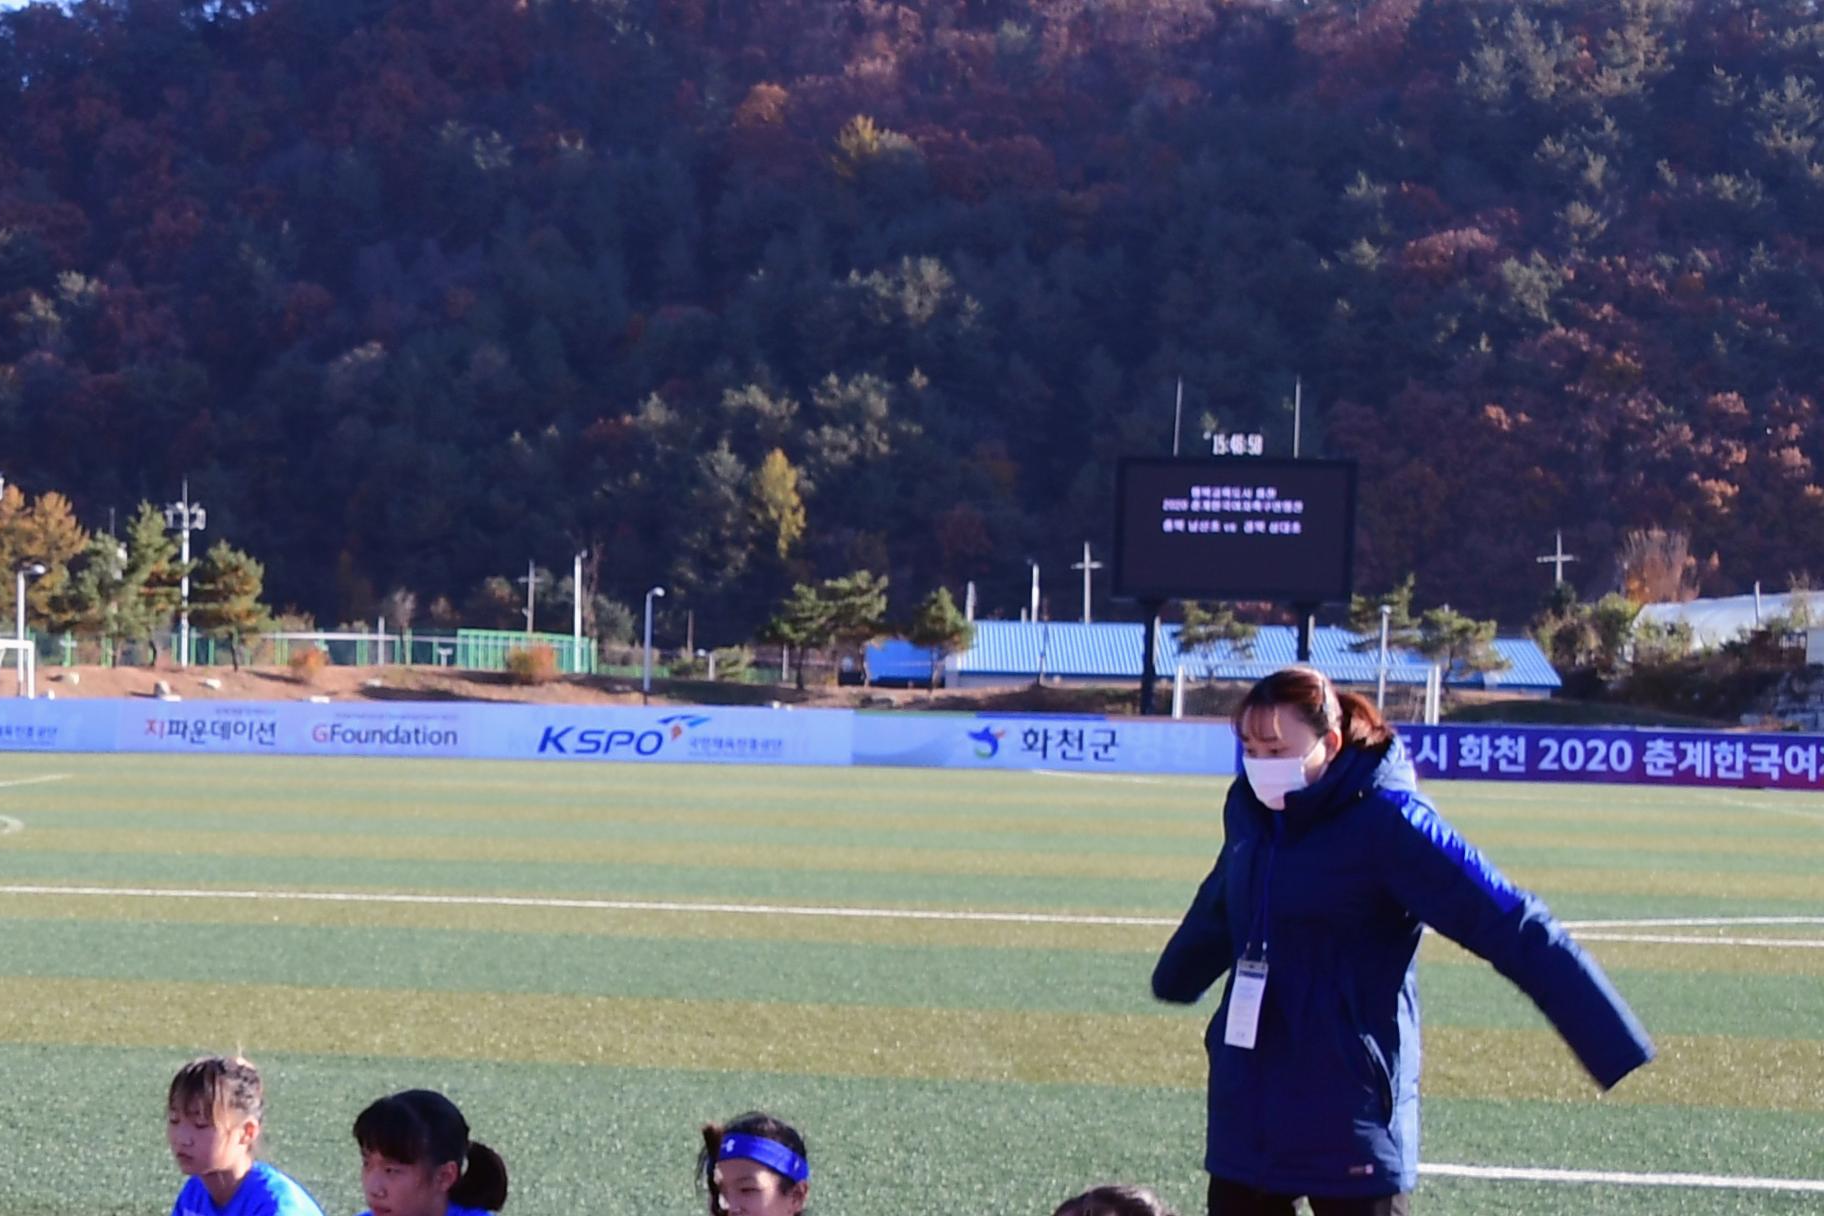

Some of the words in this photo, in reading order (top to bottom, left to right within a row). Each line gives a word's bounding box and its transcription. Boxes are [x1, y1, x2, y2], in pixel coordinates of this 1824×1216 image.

[145, 718, 276, 746] 지파운데이션
[311, 723, 459, 747] GFoundation
[537, 726, 664, 756] KSPO
[1021, 728, 1120, 762] 화천군
[1458, 733, 1526, 773] 화천
[1537, 738, 1633, 772] 2020
[1642, 738, 1824, 783] 춘계한국여
